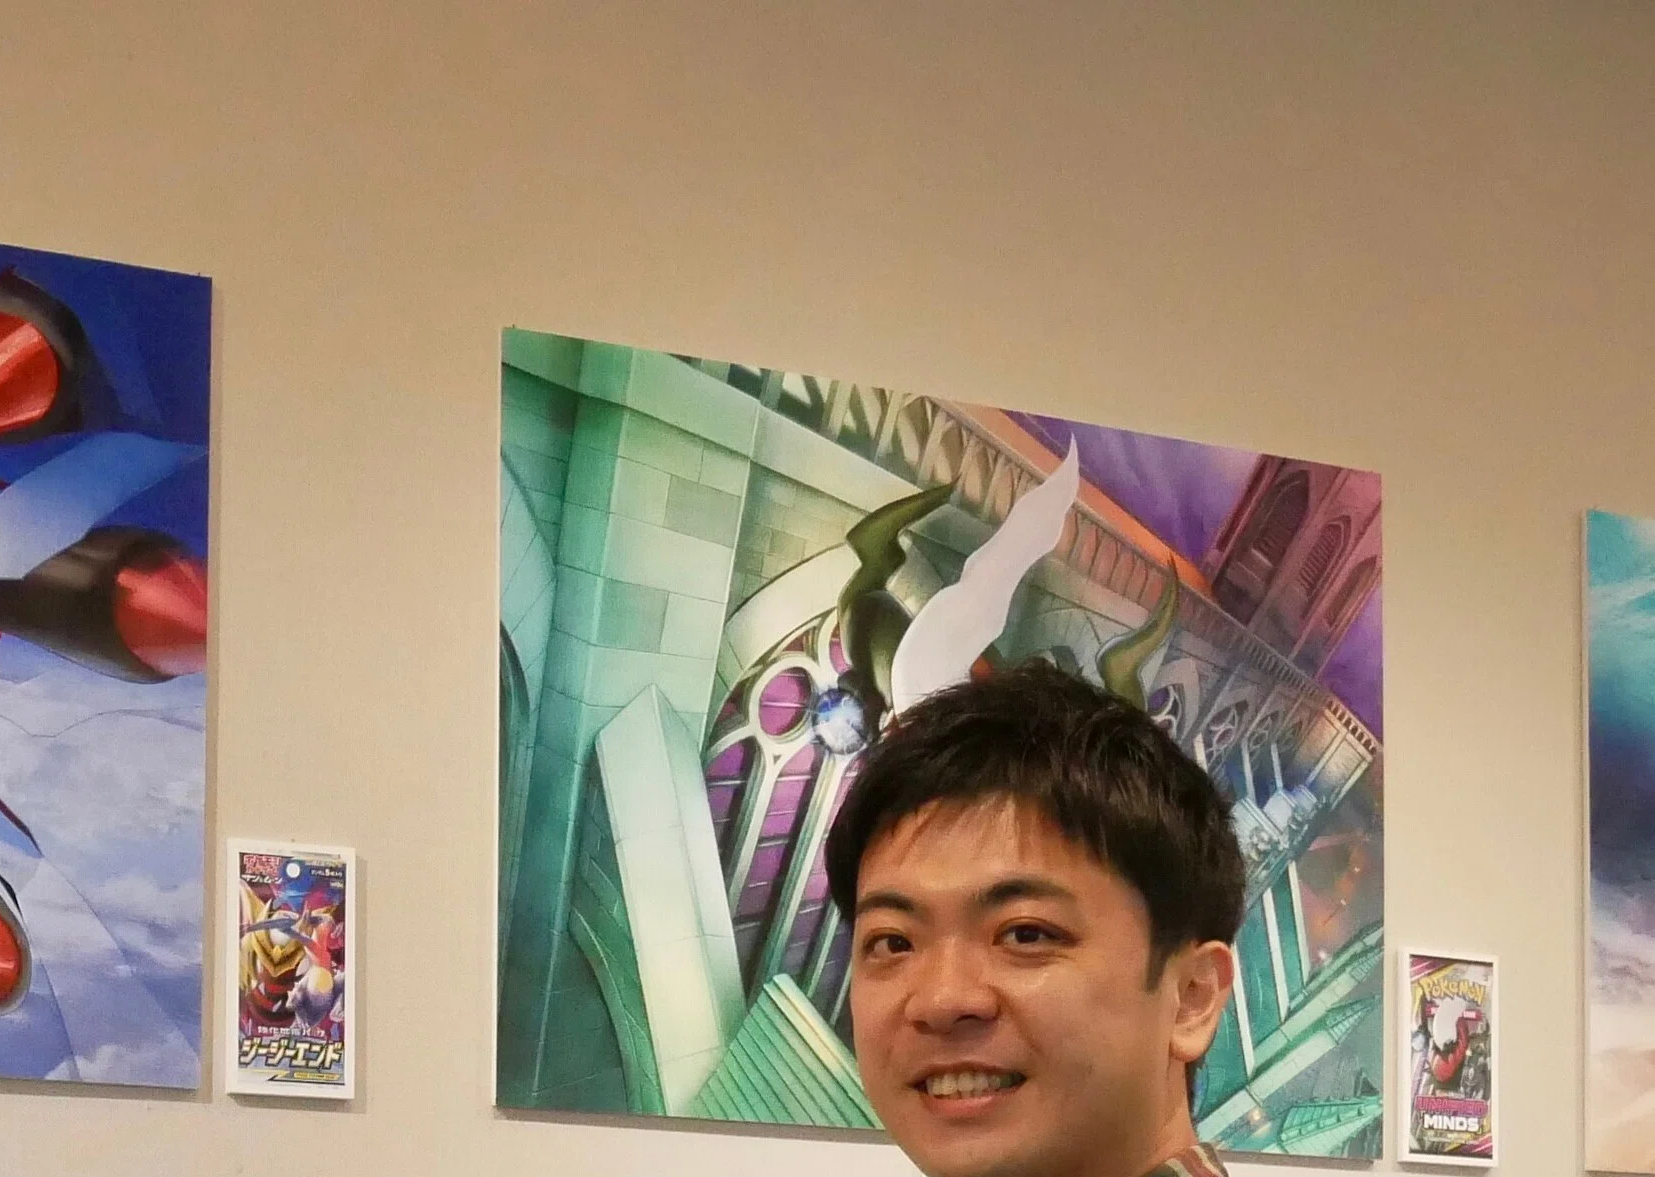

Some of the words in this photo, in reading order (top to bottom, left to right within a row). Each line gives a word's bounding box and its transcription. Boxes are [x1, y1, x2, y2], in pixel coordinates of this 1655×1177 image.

[240, 1037, 343, 1068] ジージーエンド
[1423, 1113, 1480, 1133] MINDS
